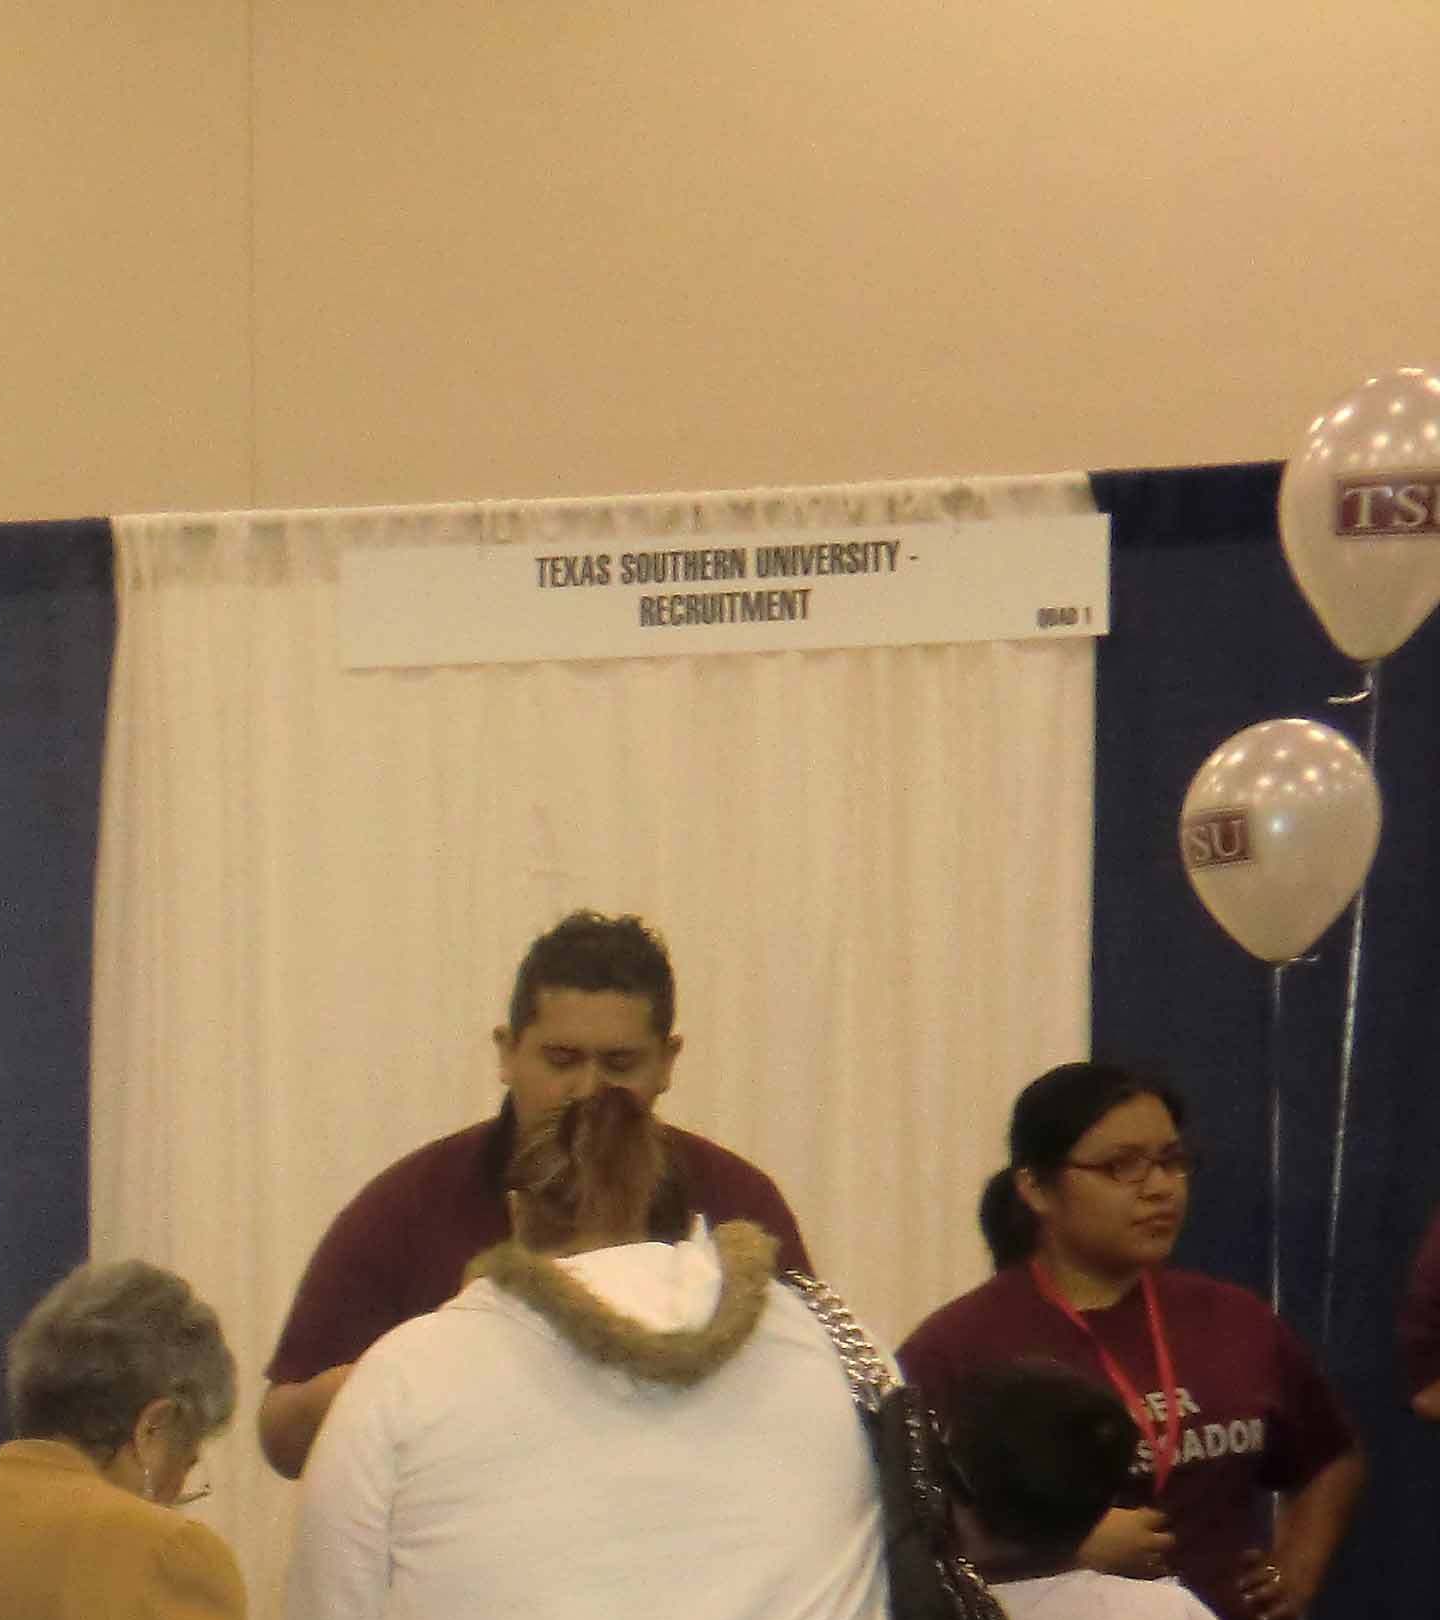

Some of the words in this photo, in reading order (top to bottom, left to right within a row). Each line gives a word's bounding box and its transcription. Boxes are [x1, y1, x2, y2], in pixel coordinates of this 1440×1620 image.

[1344, 486, 1440, 528] TS
[536, 554, 610, 587] TEXAS
[622, 549, 744, 584] SOUTHERN
[757, 542, 899, 577] UNIVERSITY
[641, 589, 810, 626] RECRUITMENT
